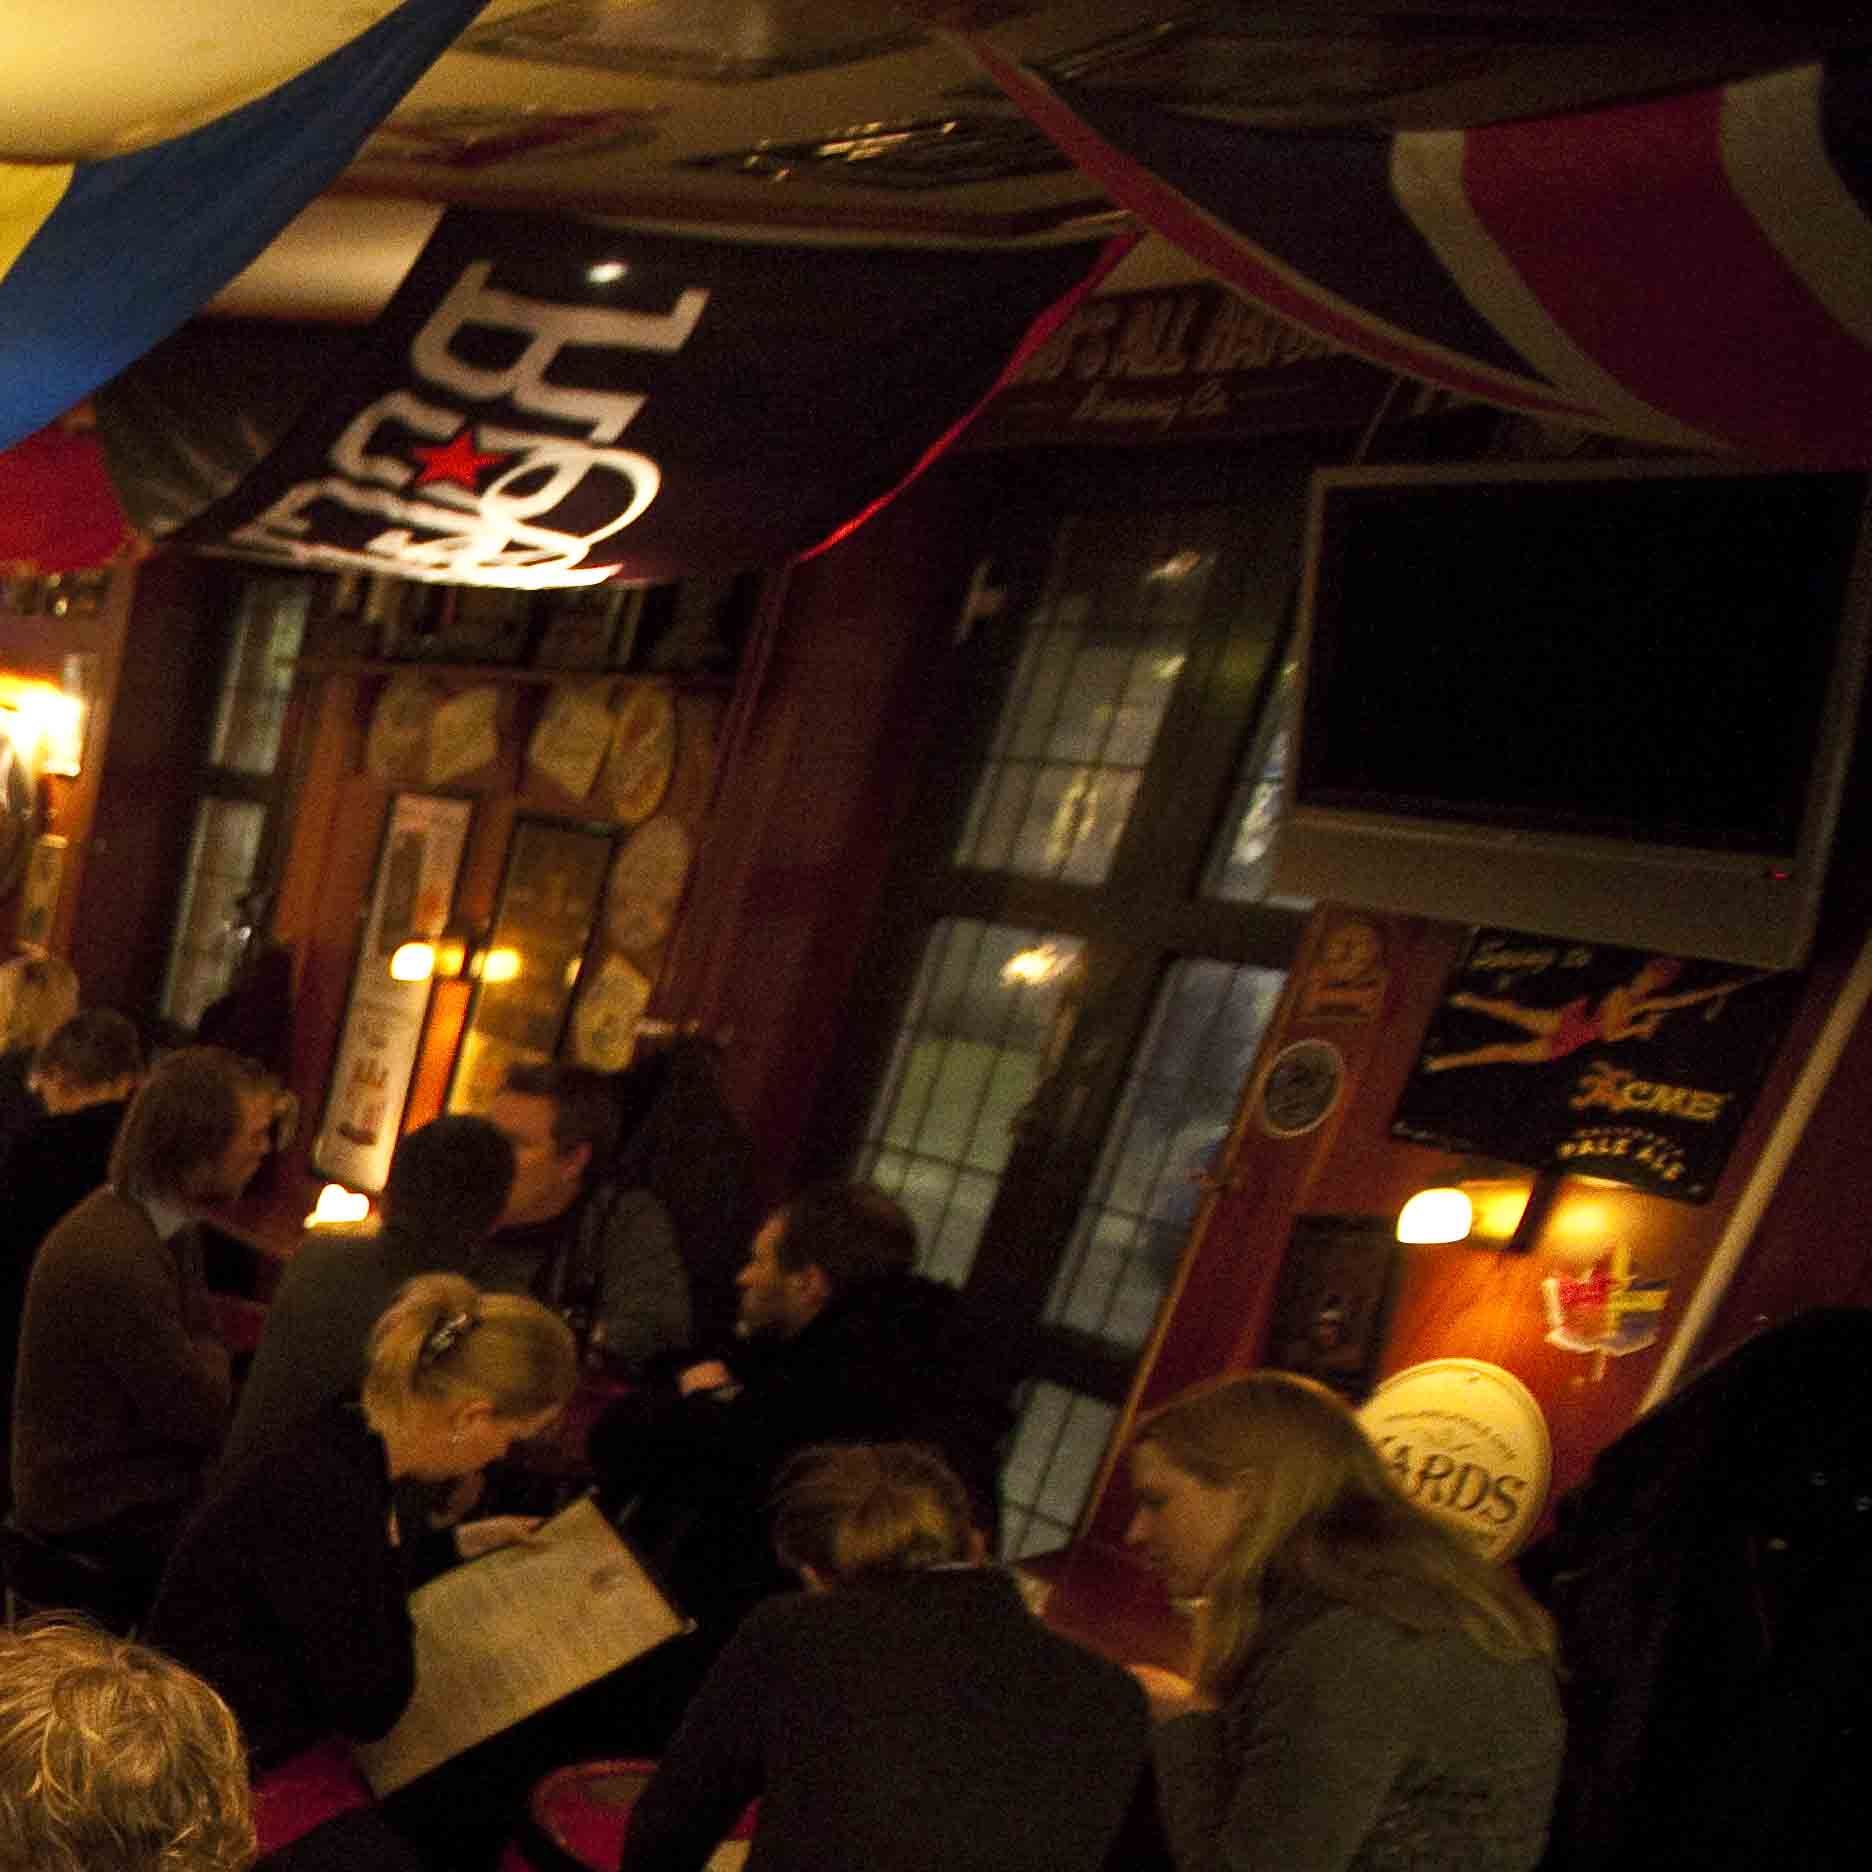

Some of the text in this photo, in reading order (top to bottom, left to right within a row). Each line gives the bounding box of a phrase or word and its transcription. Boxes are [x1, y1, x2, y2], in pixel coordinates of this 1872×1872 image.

[1568, 1060, 1726, 1122] ACME
[1557, 1138, 1629, 1163] PALE
[1381, 1434, 1526, 1527] ARDS
